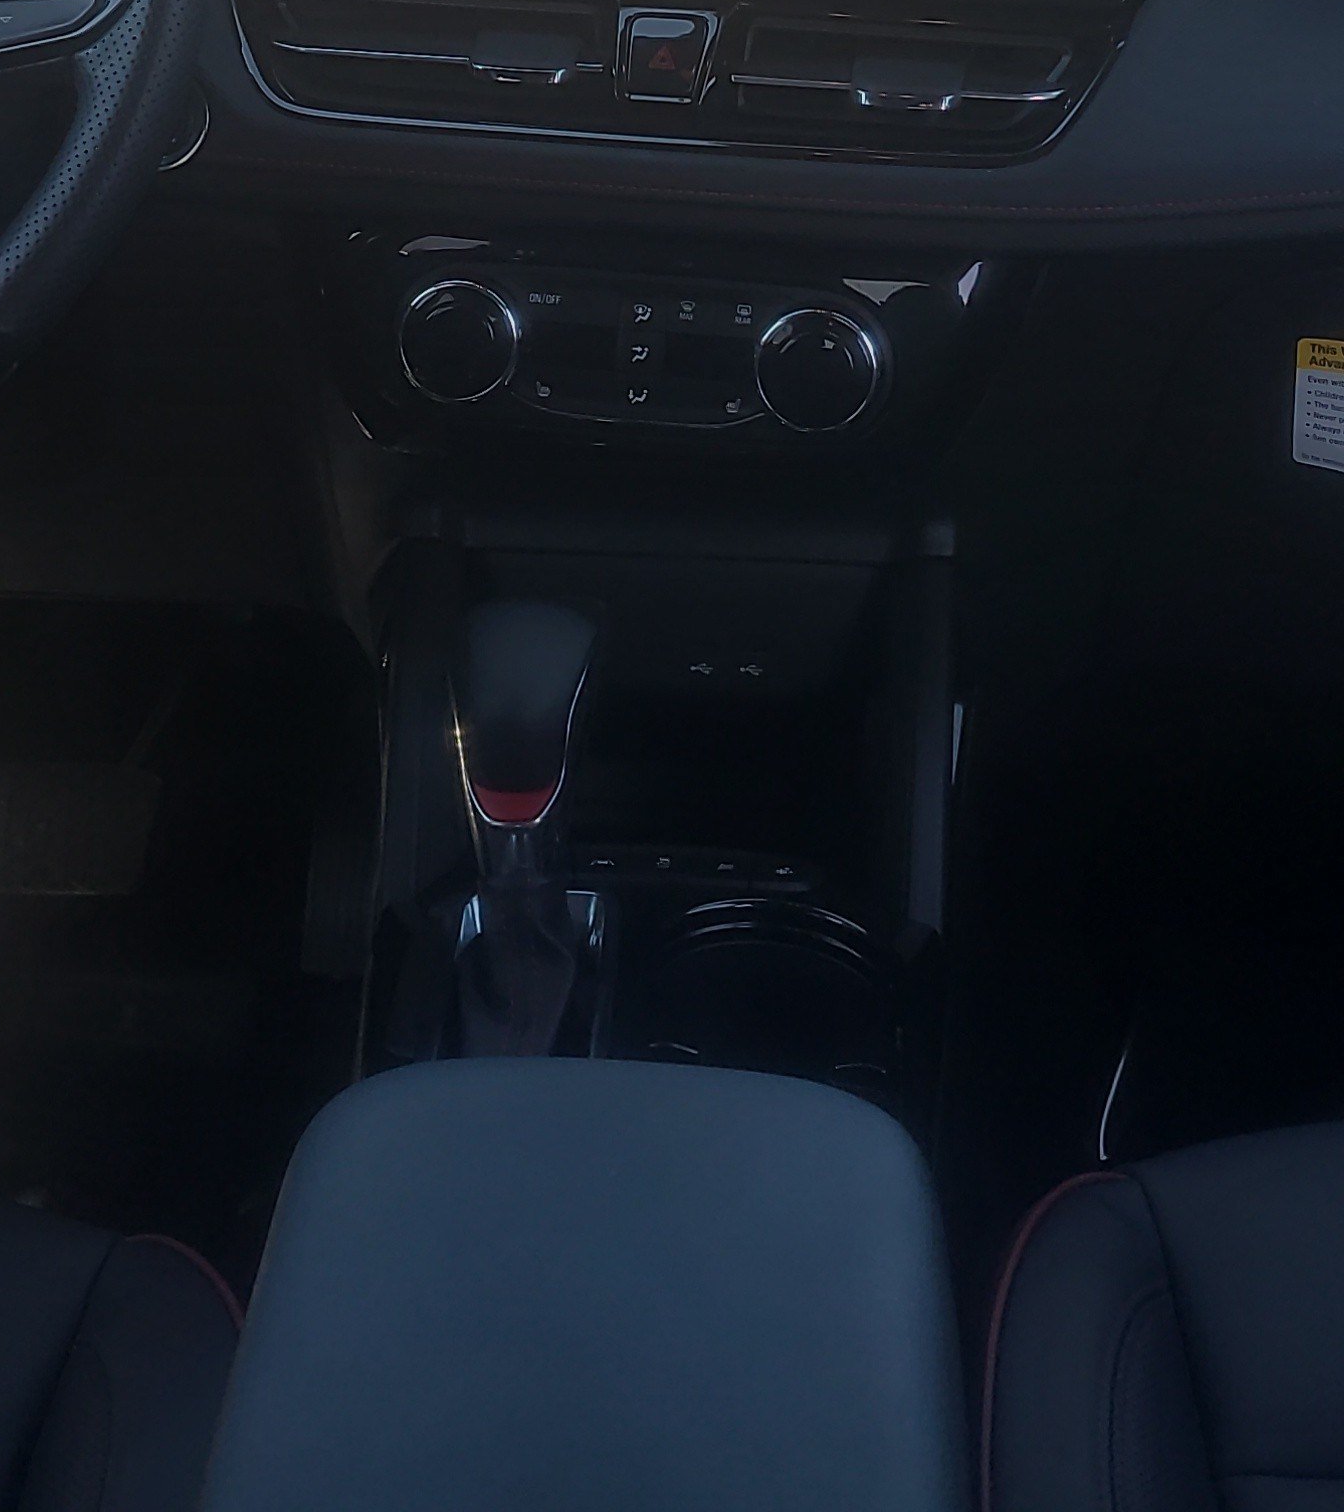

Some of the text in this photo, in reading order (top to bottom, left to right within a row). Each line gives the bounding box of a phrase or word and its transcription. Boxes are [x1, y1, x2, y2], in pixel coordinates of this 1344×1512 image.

[528, 292, 563, 304] ON/OFF
[1310, 343, 1337, 355] This
[1307, 375, 1328, 385] Even
